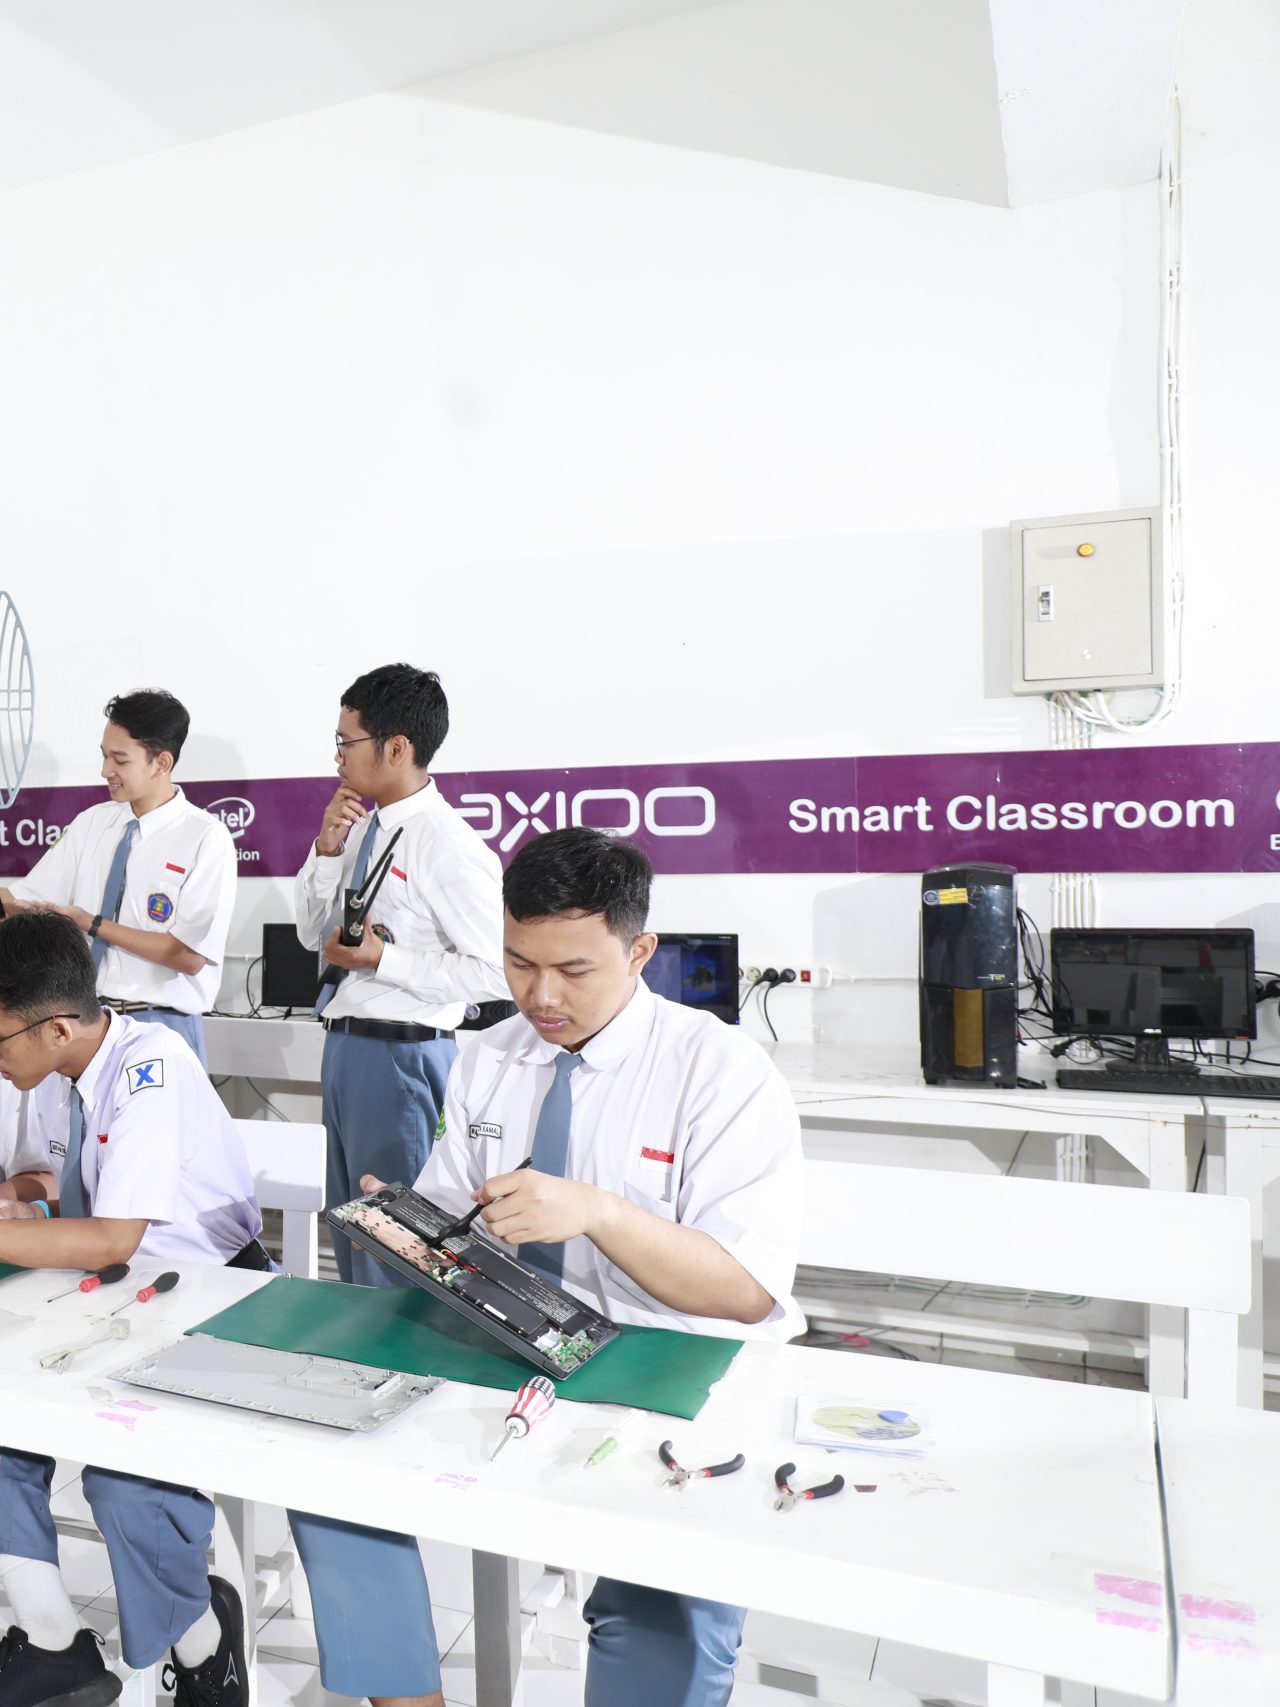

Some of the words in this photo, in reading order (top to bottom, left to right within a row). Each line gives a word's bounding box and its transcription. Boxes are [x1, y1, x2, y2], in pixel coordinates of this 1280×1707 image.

[788, 796, 934, 833] Smart
[946, 794, 1235, 831] Classroom
[134, 1063, 156, 1088] X
